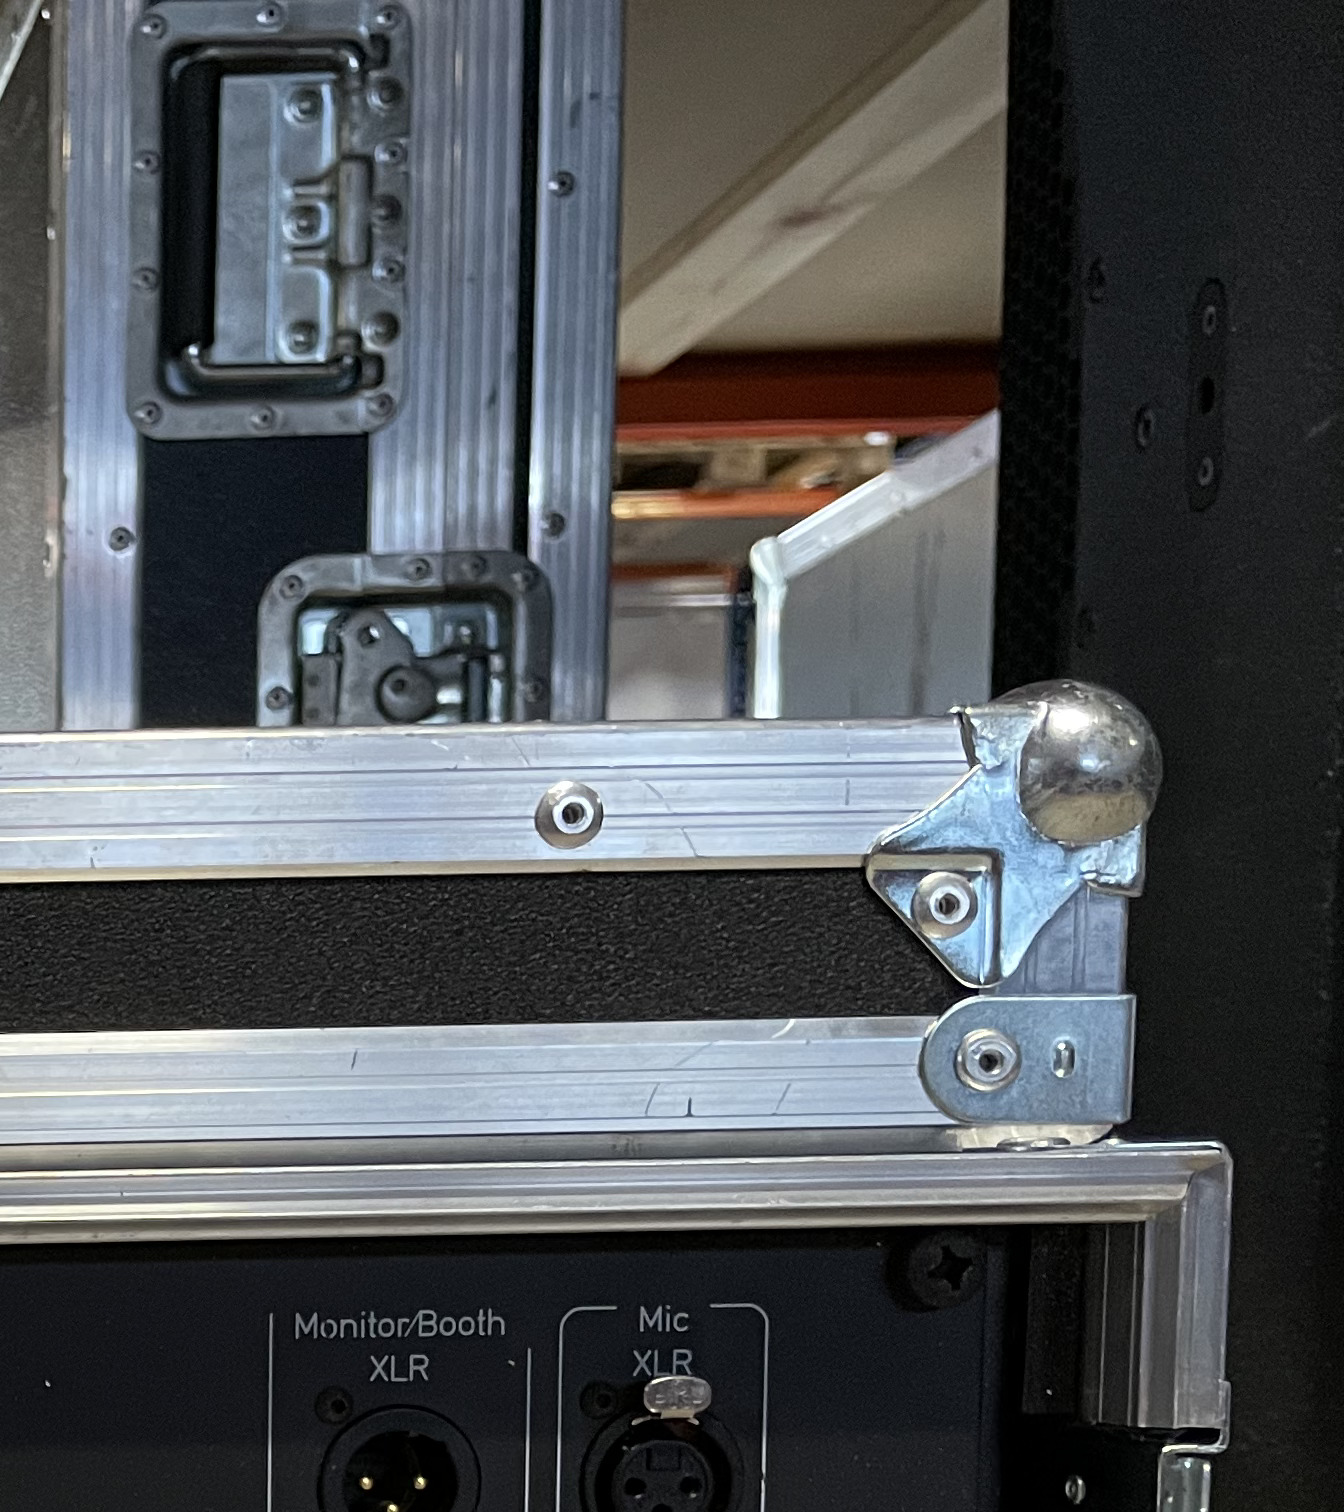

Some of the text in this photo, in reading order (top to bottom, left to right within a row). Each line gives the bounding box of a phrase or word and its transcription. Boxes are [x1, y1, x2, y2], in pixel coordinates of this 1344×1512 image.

[295, 1307, 506, 1340] Monitor/Booth
[639, 1304, 689, 1333] Mic
[369, 1354, 430, 1382] XLR
[632, 1348, 693, 1376] XLR
